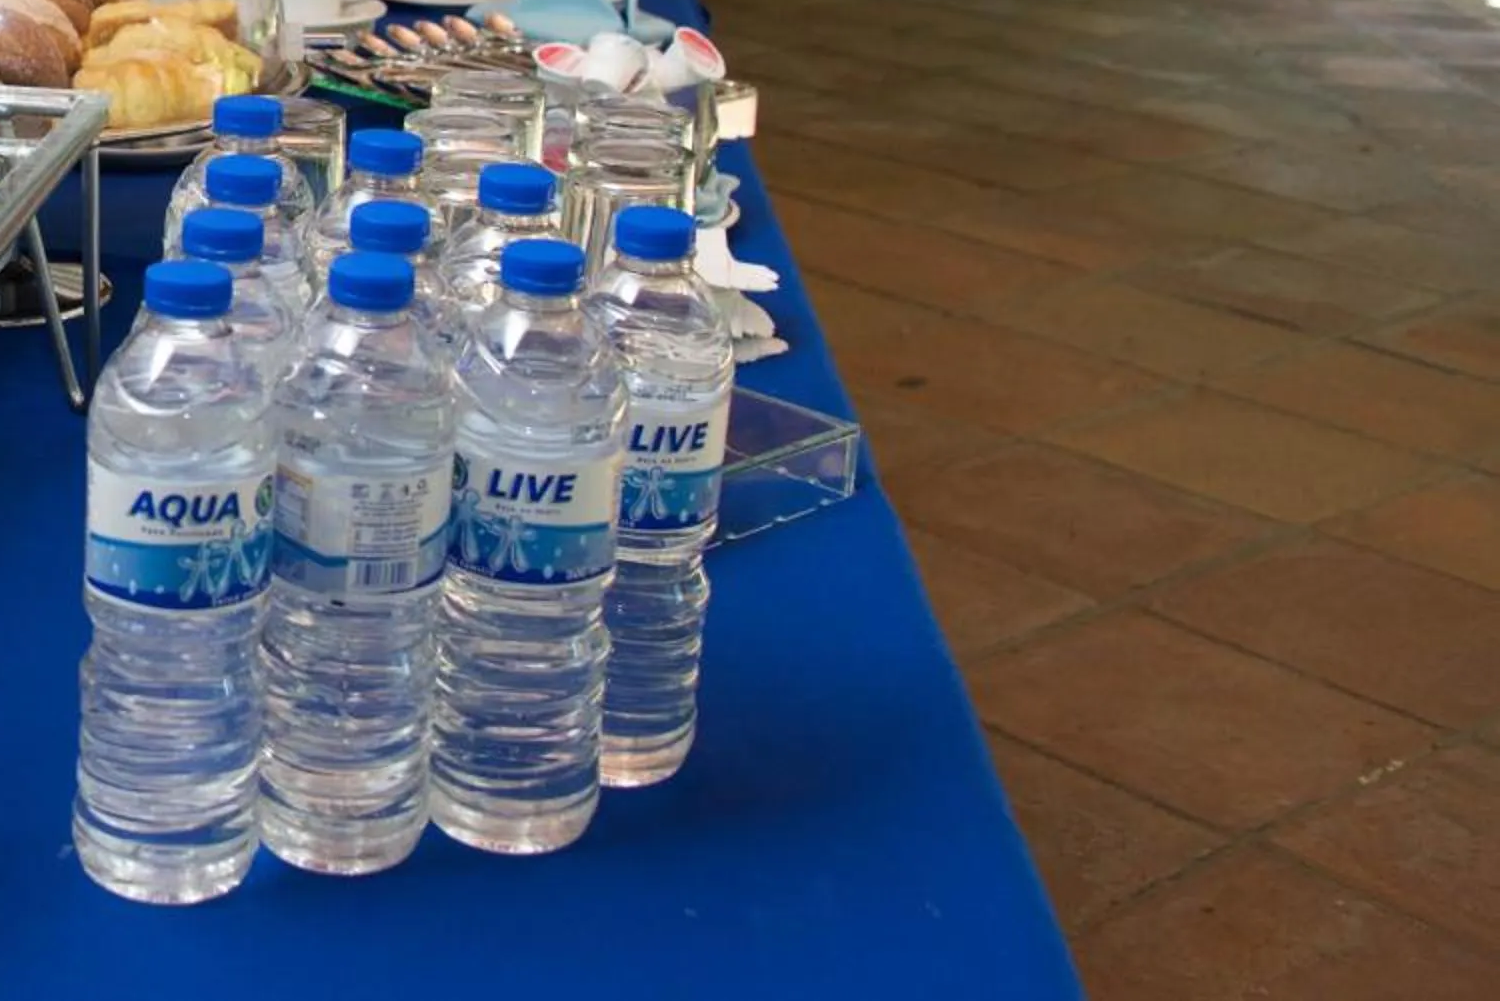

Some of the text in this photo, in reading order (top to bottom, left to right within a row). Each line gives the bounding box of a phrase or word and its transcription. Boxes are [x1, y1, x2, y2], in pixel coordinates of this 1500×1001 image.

[628, 422, 709, 453] LIVE
[487, 468, 578, 504] LIVE
[128, 490, 241, 528] AQUA
